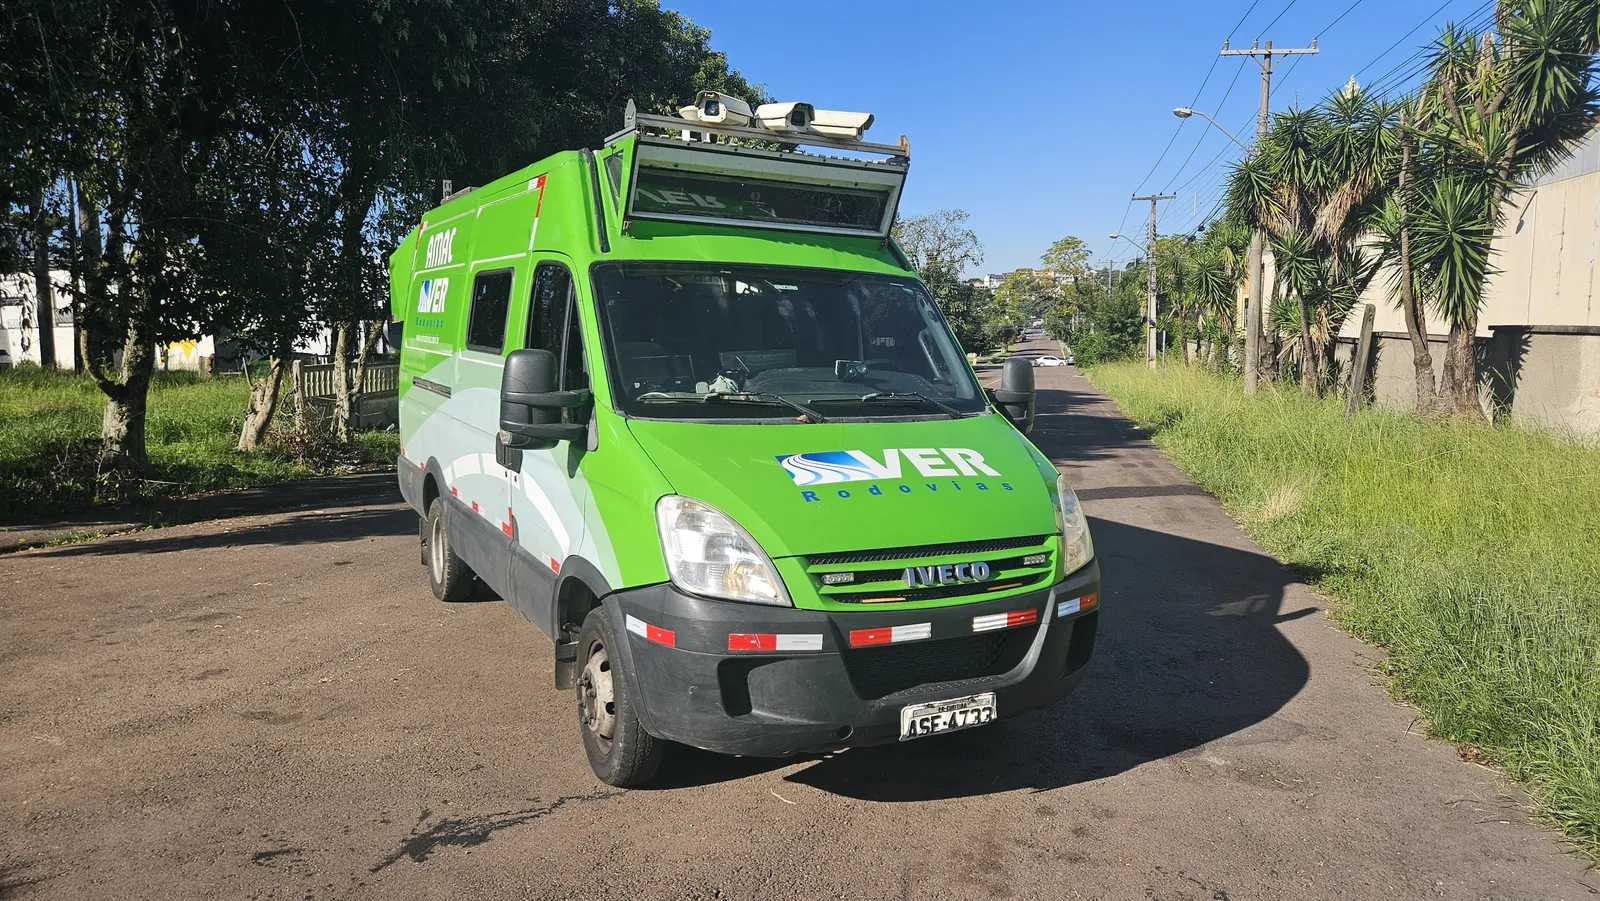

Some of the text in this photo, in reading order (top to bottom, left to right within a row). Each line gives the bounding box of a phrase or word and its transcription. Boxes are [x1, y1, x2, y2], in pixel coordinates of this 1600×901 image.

[425, 227, 457, 268] AMAC
[426, 277, 449, 313] VER
[843, 449, 1003, 478] VER
[801, 480, 1014, 503] Rodovias
[903, 561, 990, 588] IVECO
